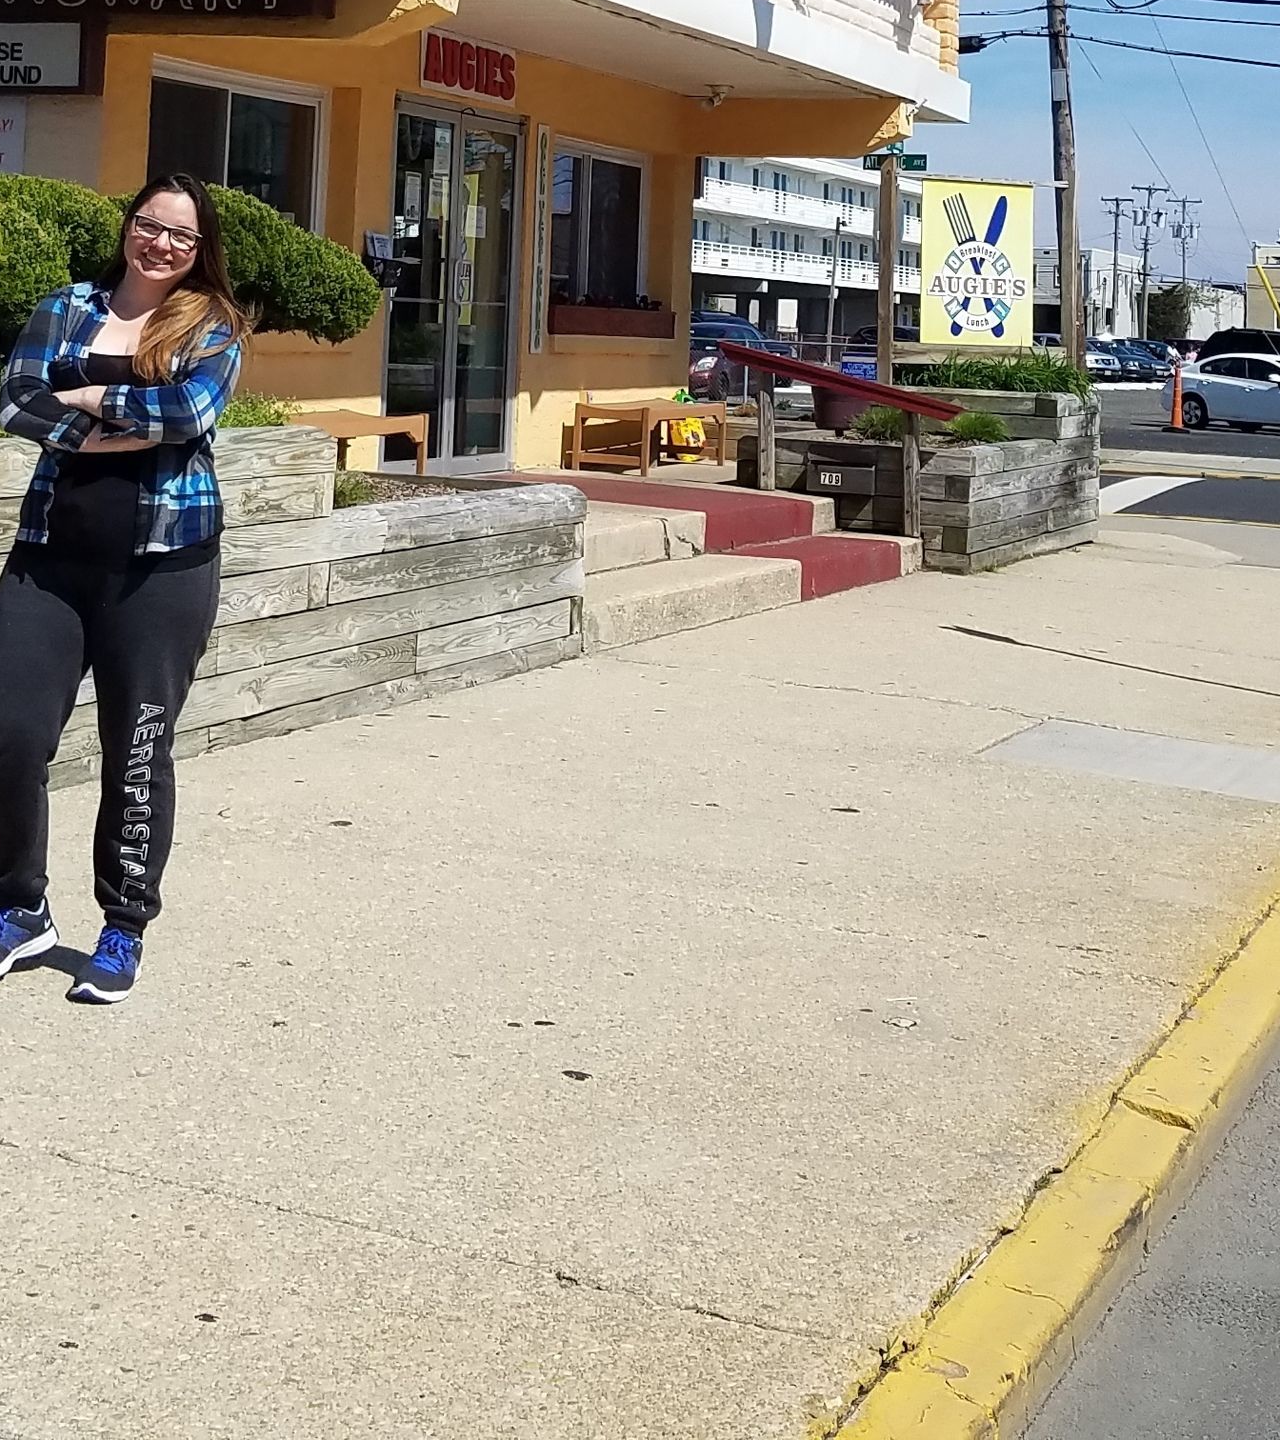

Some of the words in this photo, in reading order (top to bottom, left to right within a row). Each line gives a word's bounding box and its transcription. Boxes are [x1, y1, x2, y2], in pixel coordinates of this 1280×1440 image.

[424, 33, 515, 100] AUGIES
[865, 156, 906, 170] ATLIC
[959, 245, 997, 259] Breakfast
[929, 275, 1026, 297] AUGIE'S
[966, 316, 989, 327] Lunch
[822, 473, 840, 484] 709
